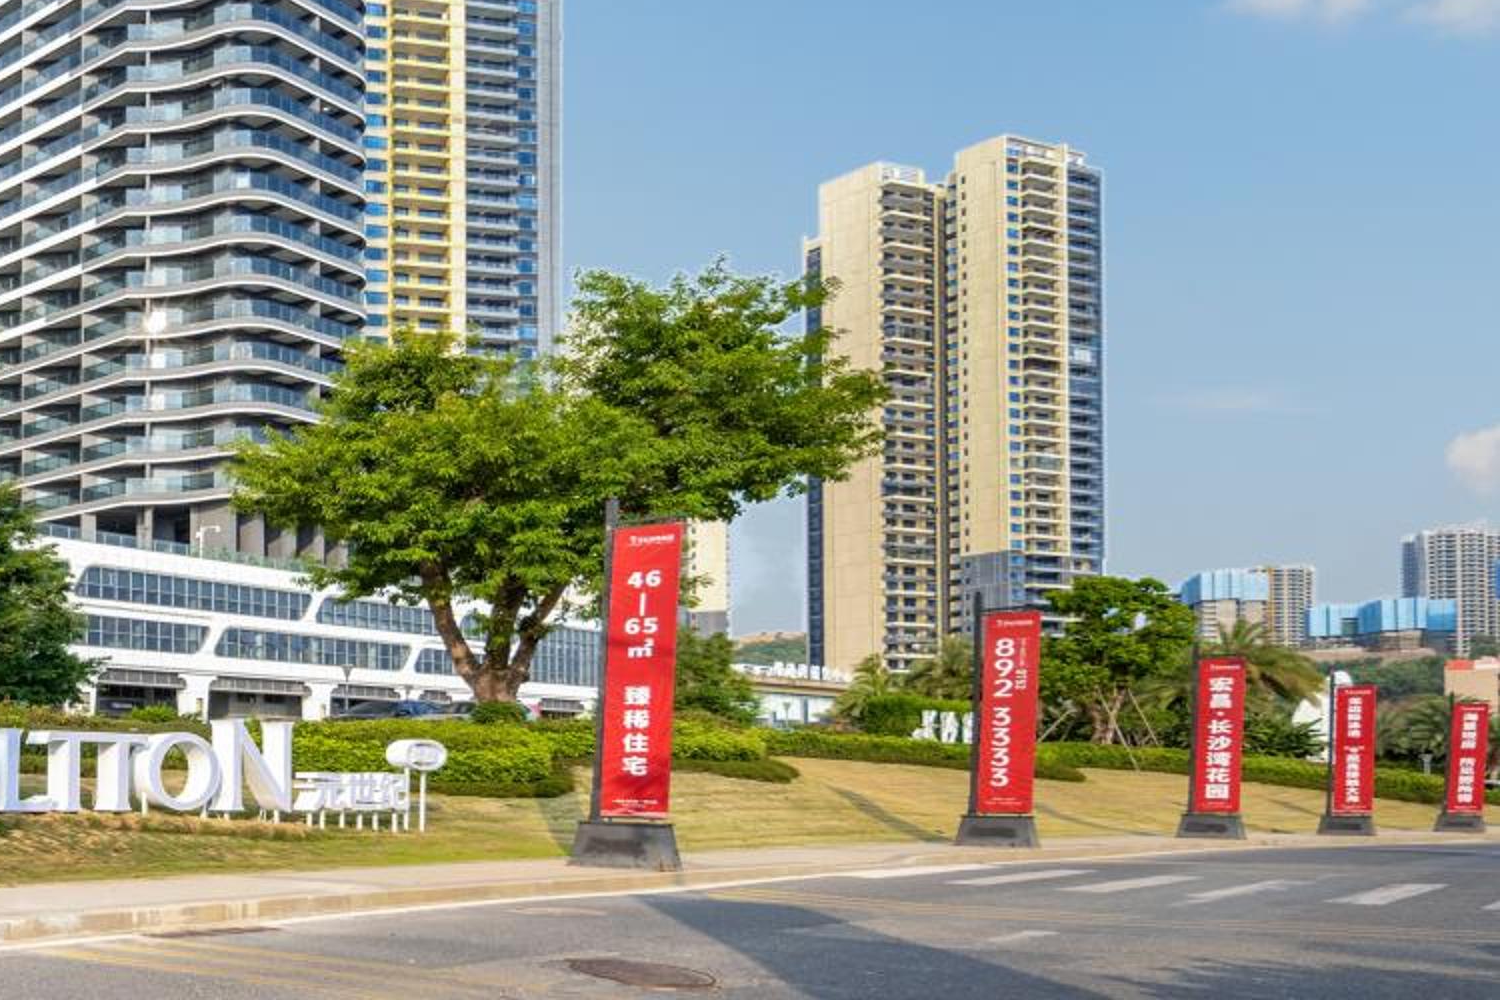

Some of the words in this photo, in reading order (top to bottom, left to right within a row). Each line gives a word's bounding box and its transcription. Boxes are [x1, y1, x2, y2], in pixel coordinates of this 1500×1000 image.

[627, 569, 661, 589] 46
[624, 617, 658, 635] 65
[994, 637, 1015, 698] 892
[989, 706, 1011, 787] 3333
